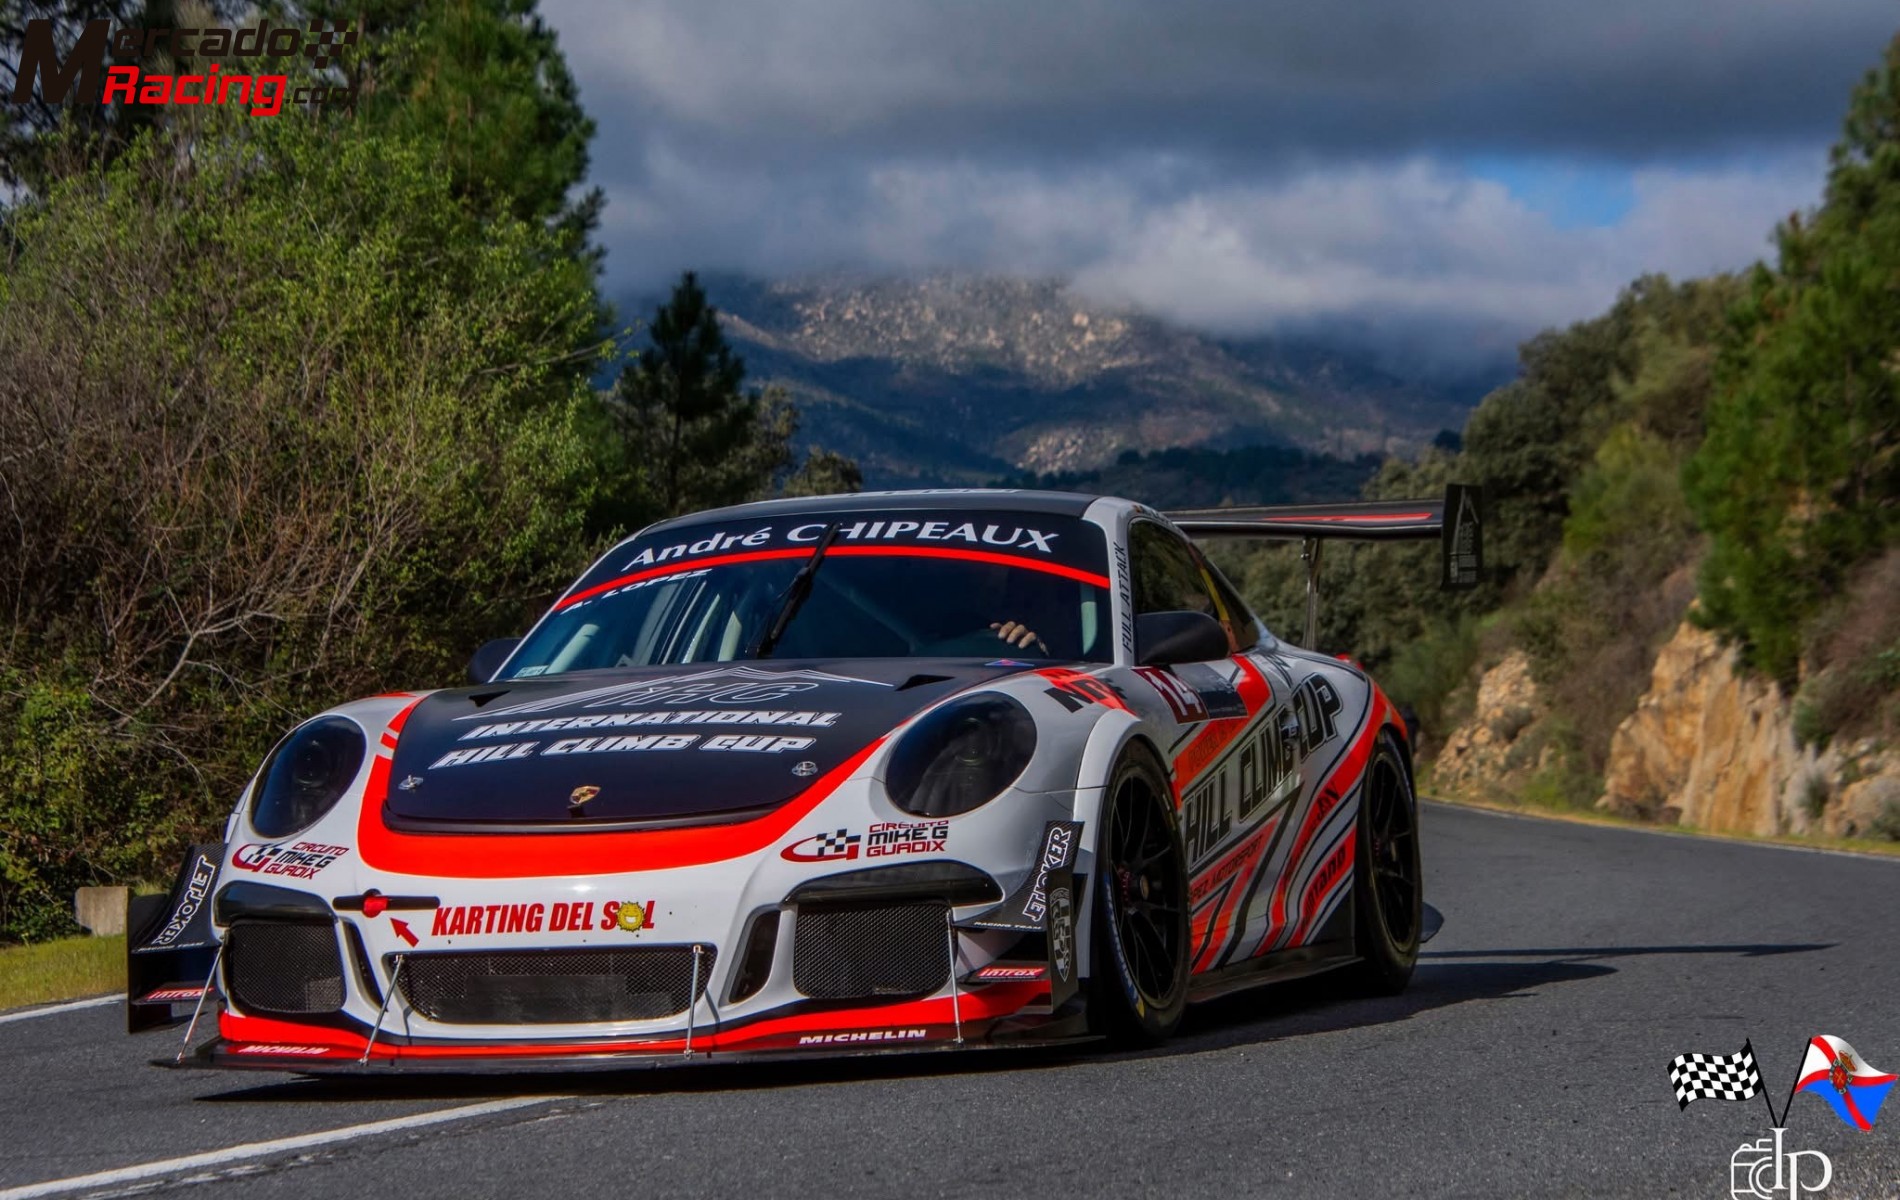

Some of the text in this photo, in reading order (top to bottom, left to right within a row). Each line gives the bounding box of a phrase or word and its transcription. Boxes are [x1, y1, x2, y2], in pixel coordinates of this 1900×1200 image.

[621, 521, 1060, 573] André CHIPEAUX
[1113, 541, 1133, 654] FULL ATTACK
[457, 710, 842, 742] INTERNATIONAL
[427, 734, 817, 770] HILL CLIMB CUP
[869, 820, 949, 834] CIRCUITO
[1183, 763, 1233, 873] HILL
[868, 825, 949, 846] MIKE G
[291, 841, 350, 857] CIRCUITO
[866, 840, 946, 858] GUADIX
[274, 850, 337, 869] MIKE G
[263, 863, 322, 880] GUADIX
[431, 903, 545, 937] KARTING
[548, 902, 594, 932] DEL
[798, 1028, 927, 1045] MICHELIN
[237, 1044, 331, 1056] MICHELIN
